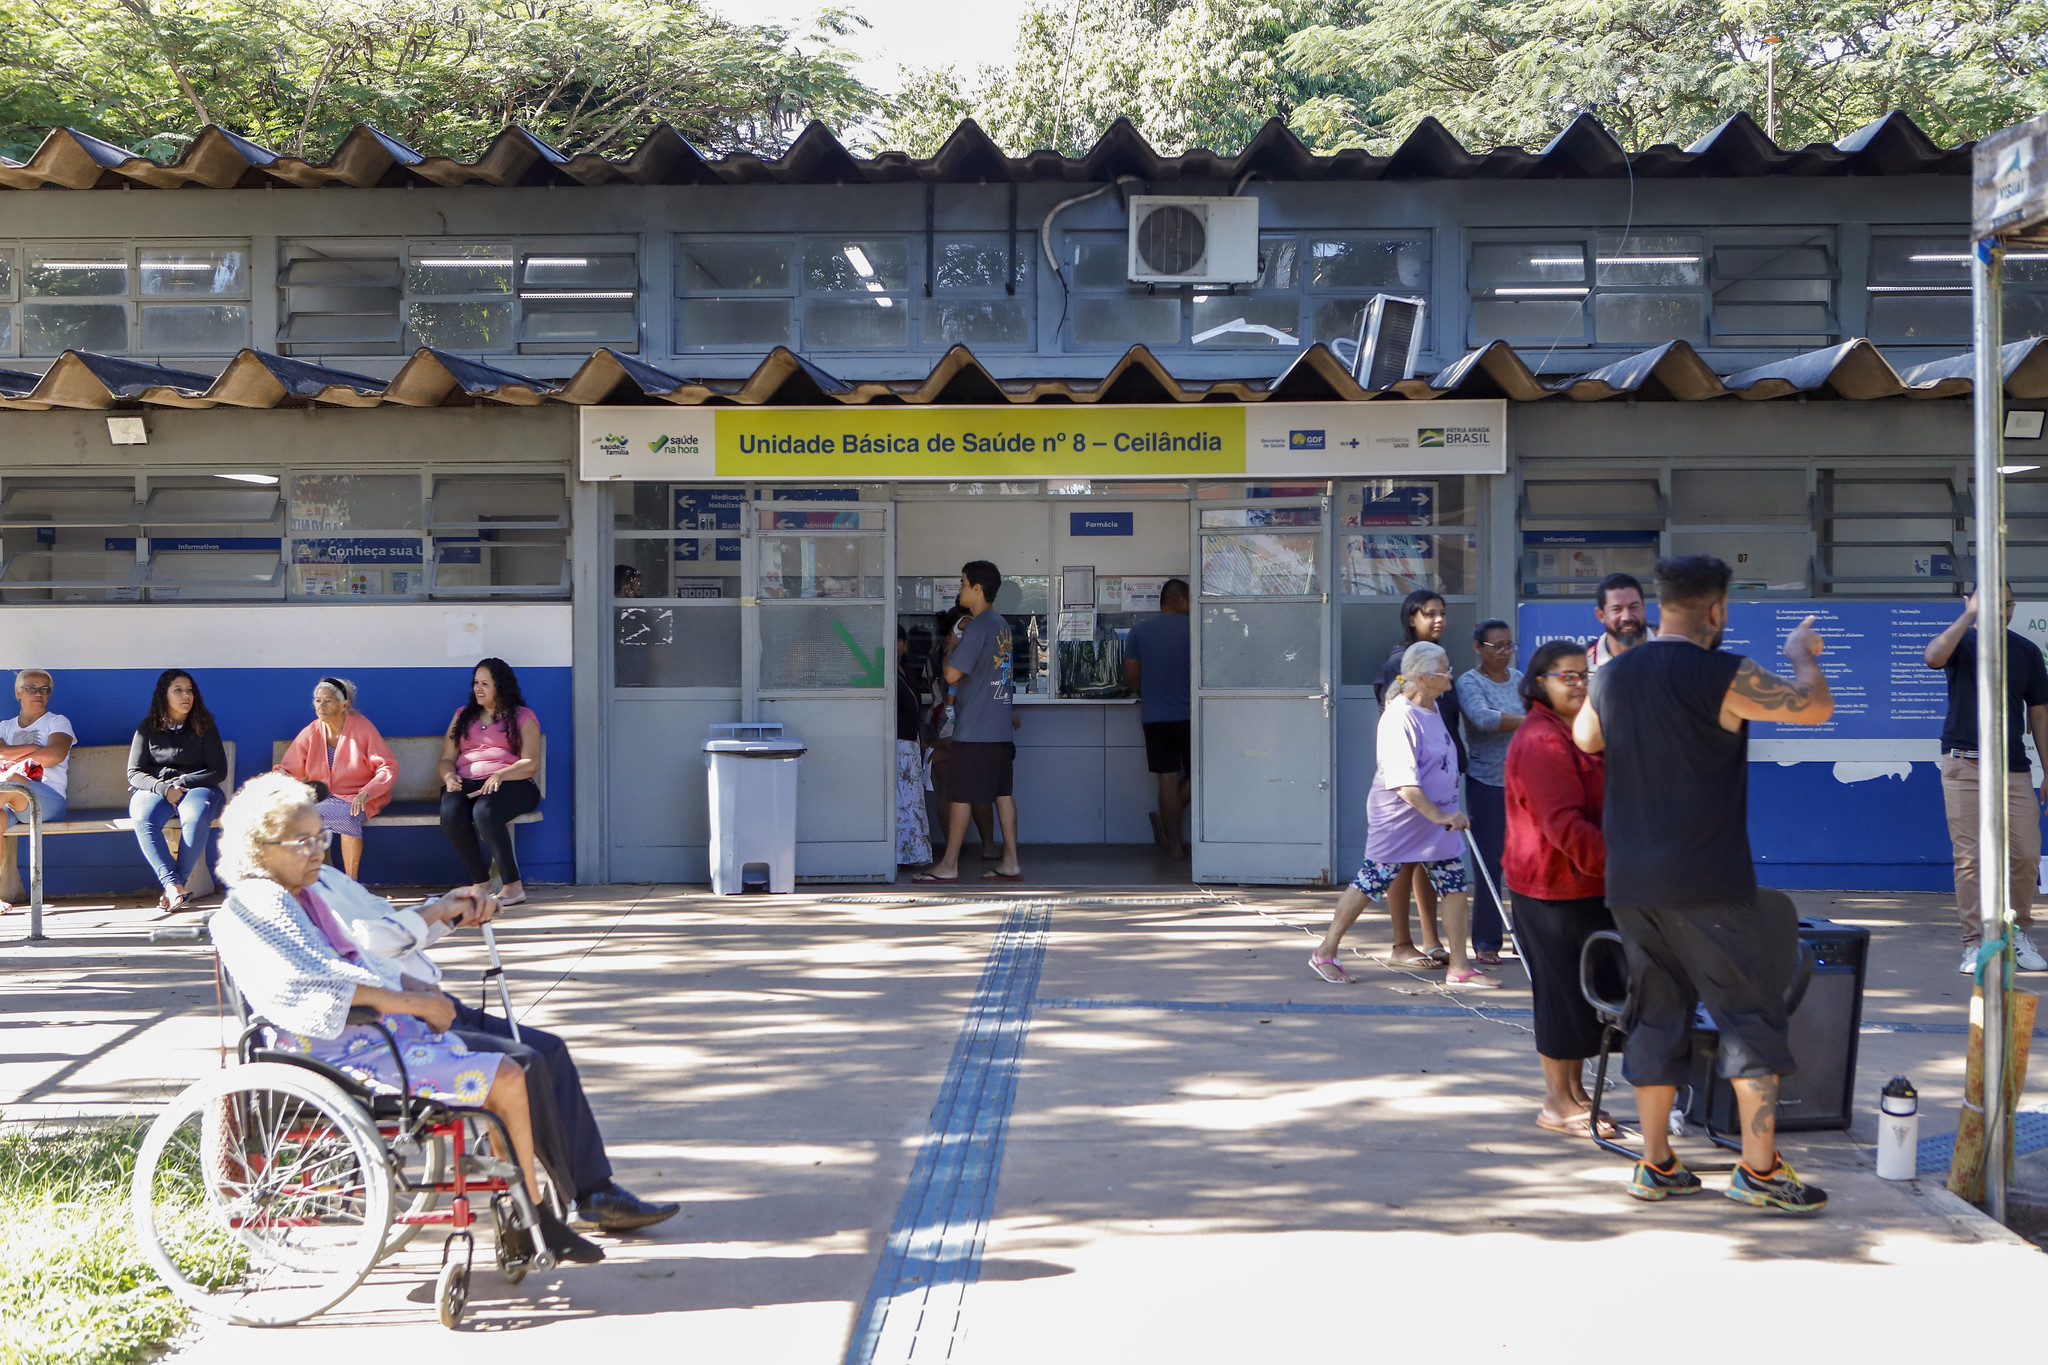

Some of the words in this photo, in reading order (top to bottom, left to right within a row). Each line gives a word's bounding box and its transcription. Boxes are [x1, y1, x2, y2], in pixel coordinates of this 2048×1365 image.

[670, 435, 699, 445] saúde
[739, 434, 836, 454] Unidade
[842, 433, 920, 454] Básica
[926, 433, 956, 453] de
[962, 432, 1036, 453] Saúde
[1042, 432, 1067, 452] nº
[1072, 433, 1087, 453] 8
[1113, 432, 1223, 452] Ceilândia
[1307, 436, 1324, 444] GDF
[1446, 433, 1490, 443] BRASIL
[664, 446, 676, 454] na
[677, 445, 699, 454] hora
[711, 493, 747, 502] Medicação
[803, 521, 853, 529] Administração
[328, 545, 387, 559] Conheça
[390, 548, 414, 556] sua
[1737, 553, 1748, 563] 07
[2028, 618, 2048, 633] AQ
